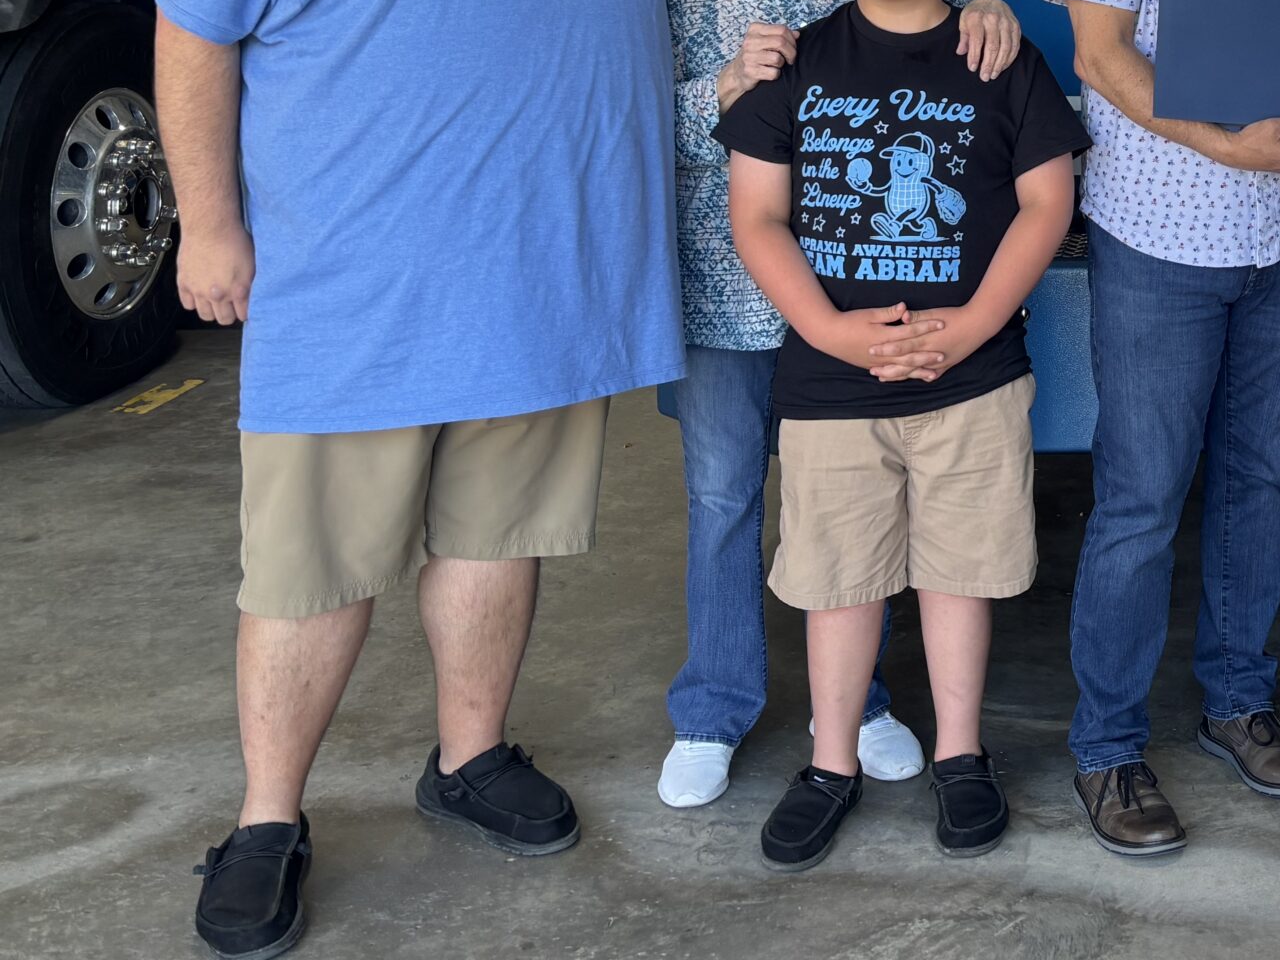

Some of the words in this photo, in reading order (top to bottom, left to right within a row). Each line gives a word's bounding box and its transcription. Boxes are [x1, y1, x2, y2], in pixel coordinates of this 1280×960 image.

[798, 85, 880, 128] Every
[889, 88, 976, 123] Voice
[800, 126, 876, 160] Belongs
[802, 161, 818, 178] in
[818, 157, 840, 180] the
[801, 182, 863, 217] Lineup
[800, 236, 848, 256] APRAXIA
[851, 244, 961, 259] AWARENESS
[804, 250, 846, 279] EAM
[854, 257, 961, 283] ABRAM
